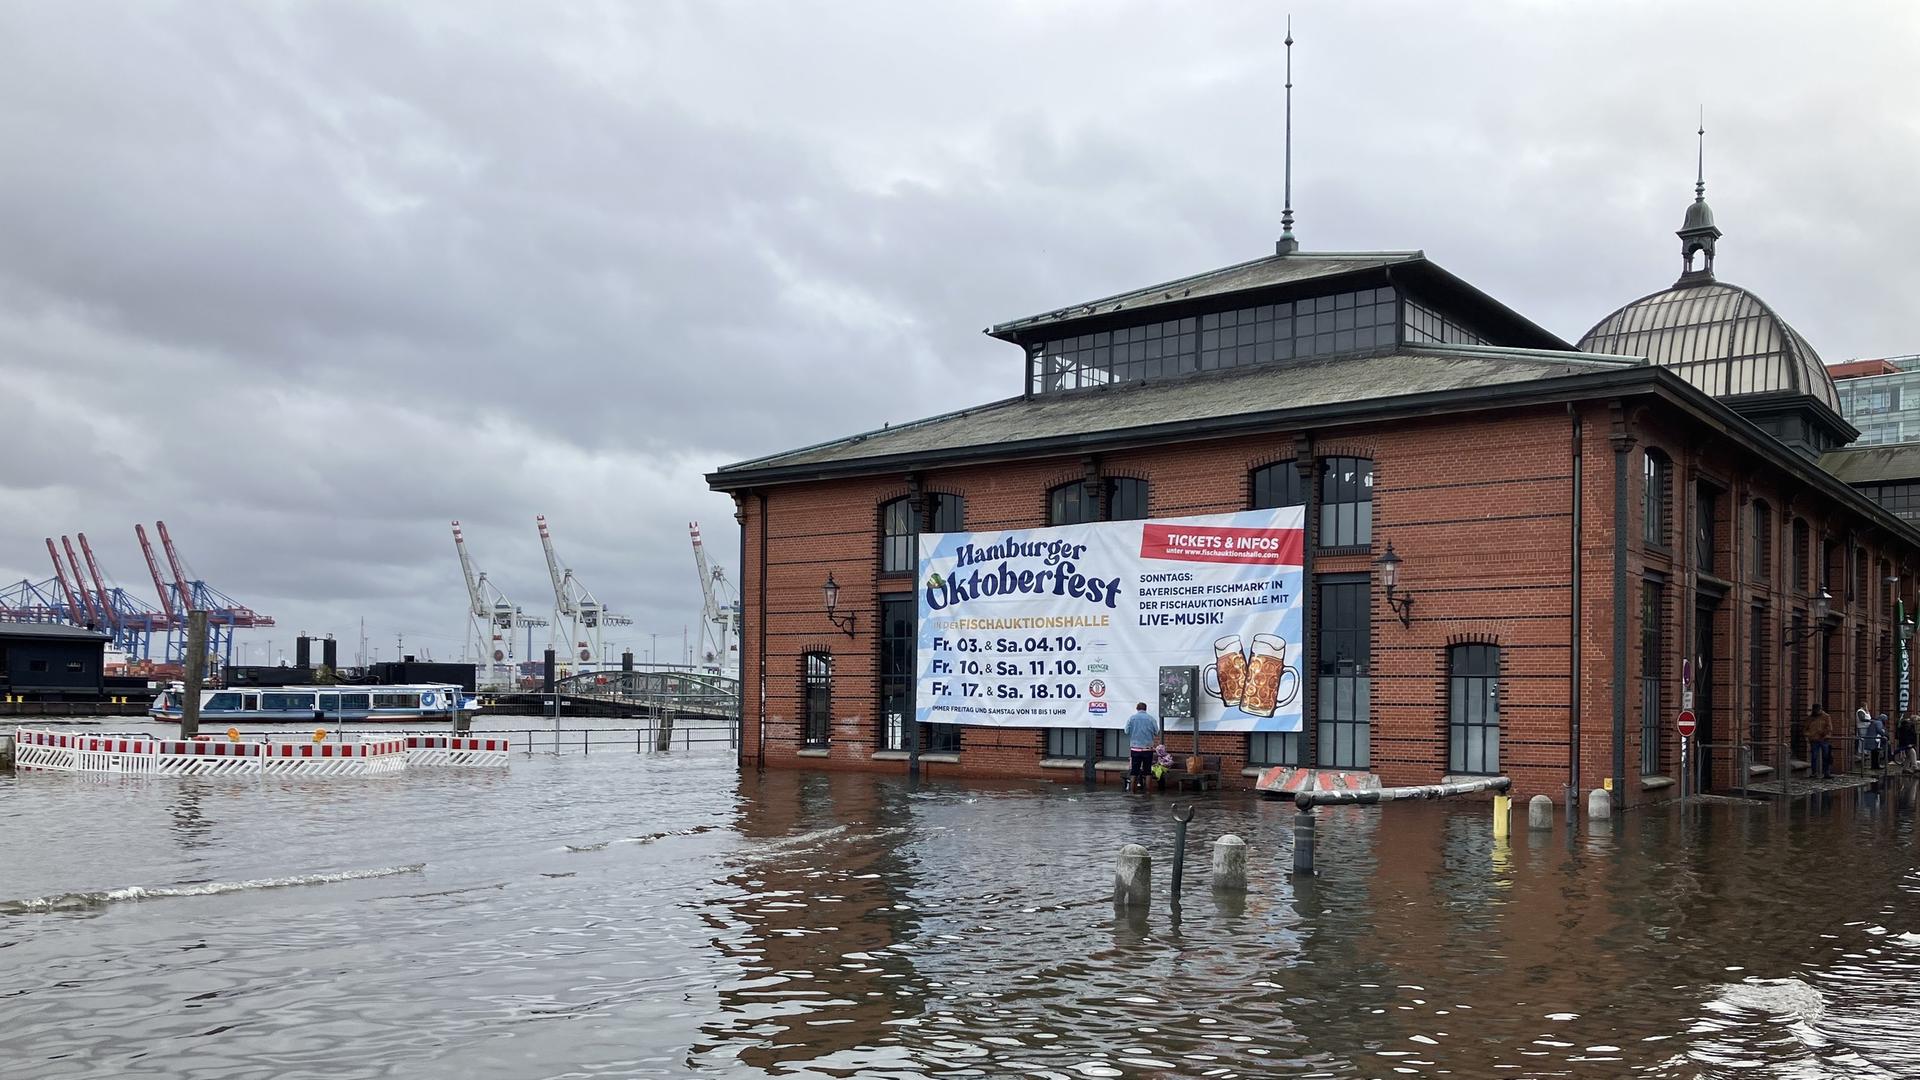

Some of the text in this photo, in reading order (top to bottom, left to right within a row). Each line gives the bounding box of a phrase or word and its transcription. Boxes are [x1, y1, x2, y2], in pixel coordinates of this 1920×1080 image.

[1167, 534, 1280, 550] TICKETS & INFOS
[956, 536, 1088, 568] Hamburger
[1184, 548, 1280, 559] www.fischauktionshalle.com
[926, 561, 1122, 610] Oktoberfest
[1140, 572, 1193, 583] SONNTAGS:
[1139, 580, 1284, 597] BAYERISCHER FISCHMARKT IN
[1139, 594, 1290, 611] DER FISCHAUKTIONSHALLE MIT
[959, 615, 1110, 631] FISCHAUKTIONSHALLE
[1139, 612, 1225, 627] LIVE-MUSIK!
[932, 637, 953, 651] Fr.
[957, 638, 983, 653] 03.
[985, 641, 993, 651] &
[997, 638, 1023, 653] Sa.
[932, 660, 953, 673] Fr.
[960, 661, 984, 675] 10.
[985, 664, 993, 673] &
[997, 661, 1023, 675] Sa.
[932, 682, 953, 697] Fr.
[961, 683, 984, 699] 17.
[987, 686, 994, 697] &
[997, 683, 1023, 699] Sa.
